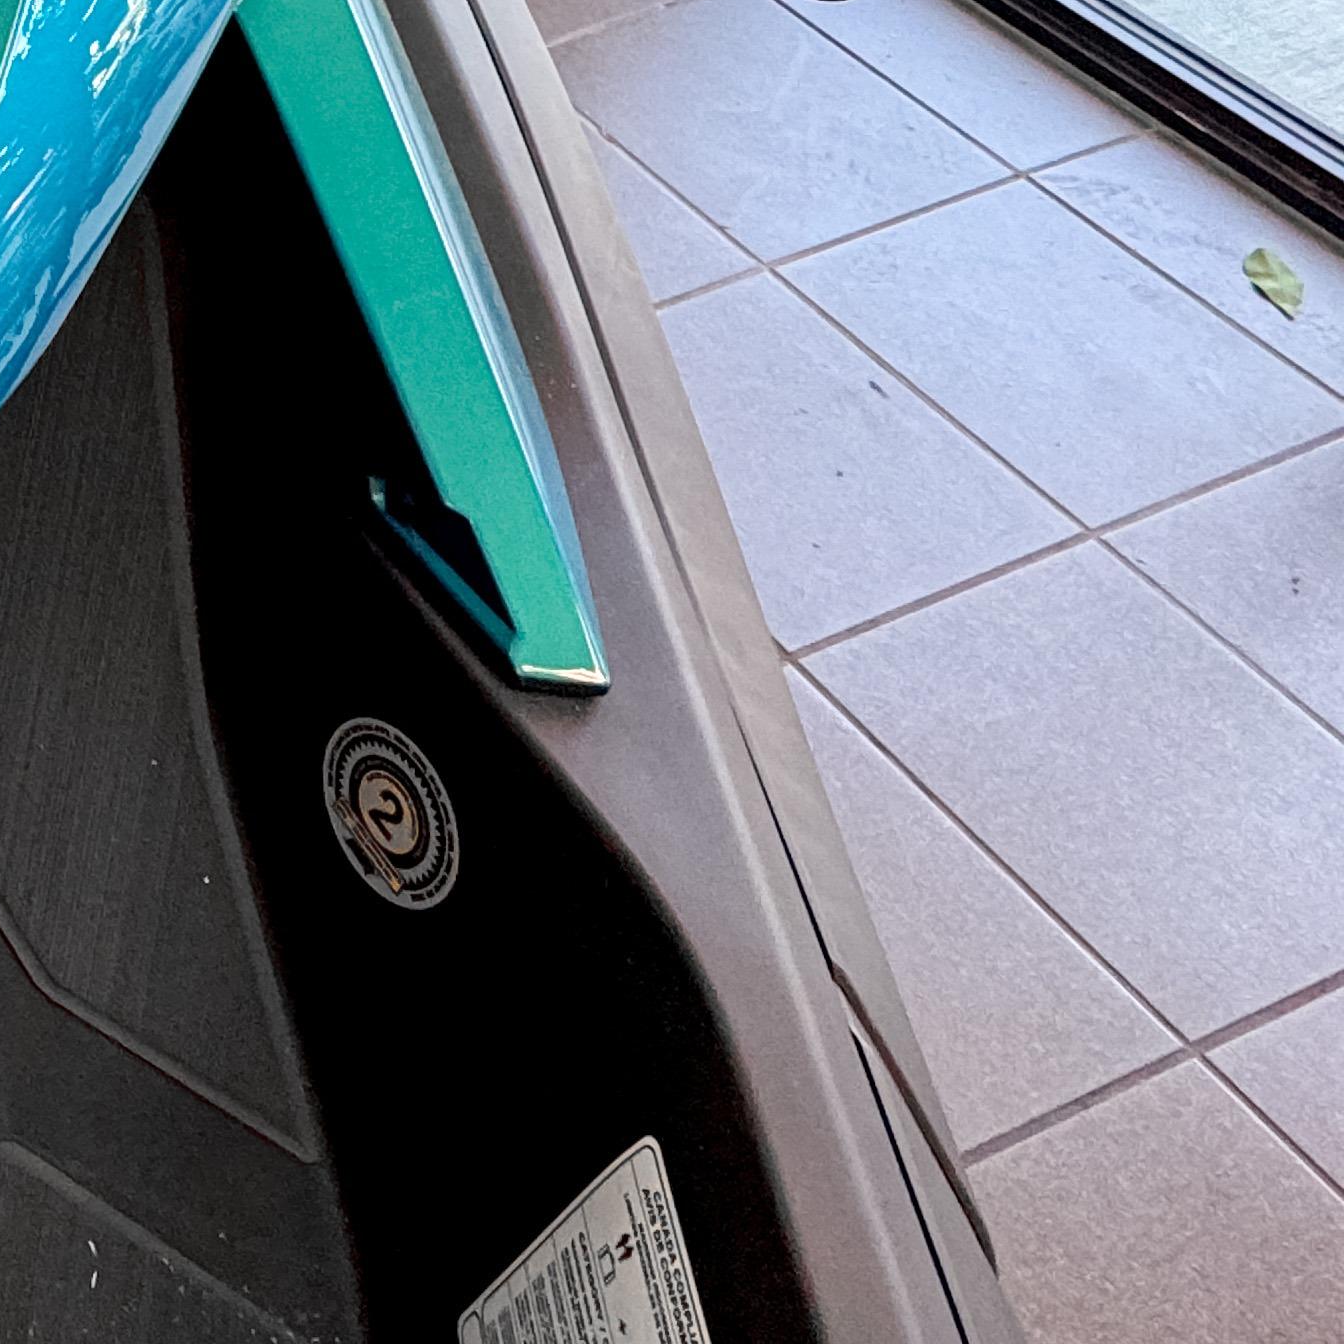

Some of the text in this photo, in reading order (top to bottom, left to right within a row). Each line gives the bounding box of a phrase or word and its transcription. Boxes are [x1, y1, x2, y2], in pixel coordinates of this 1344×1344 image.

[642, 1188, 657, 1227] AVIS
[653, 1229, 665, 1254] DE
[653, 1190, 677, 1266] CANADA
